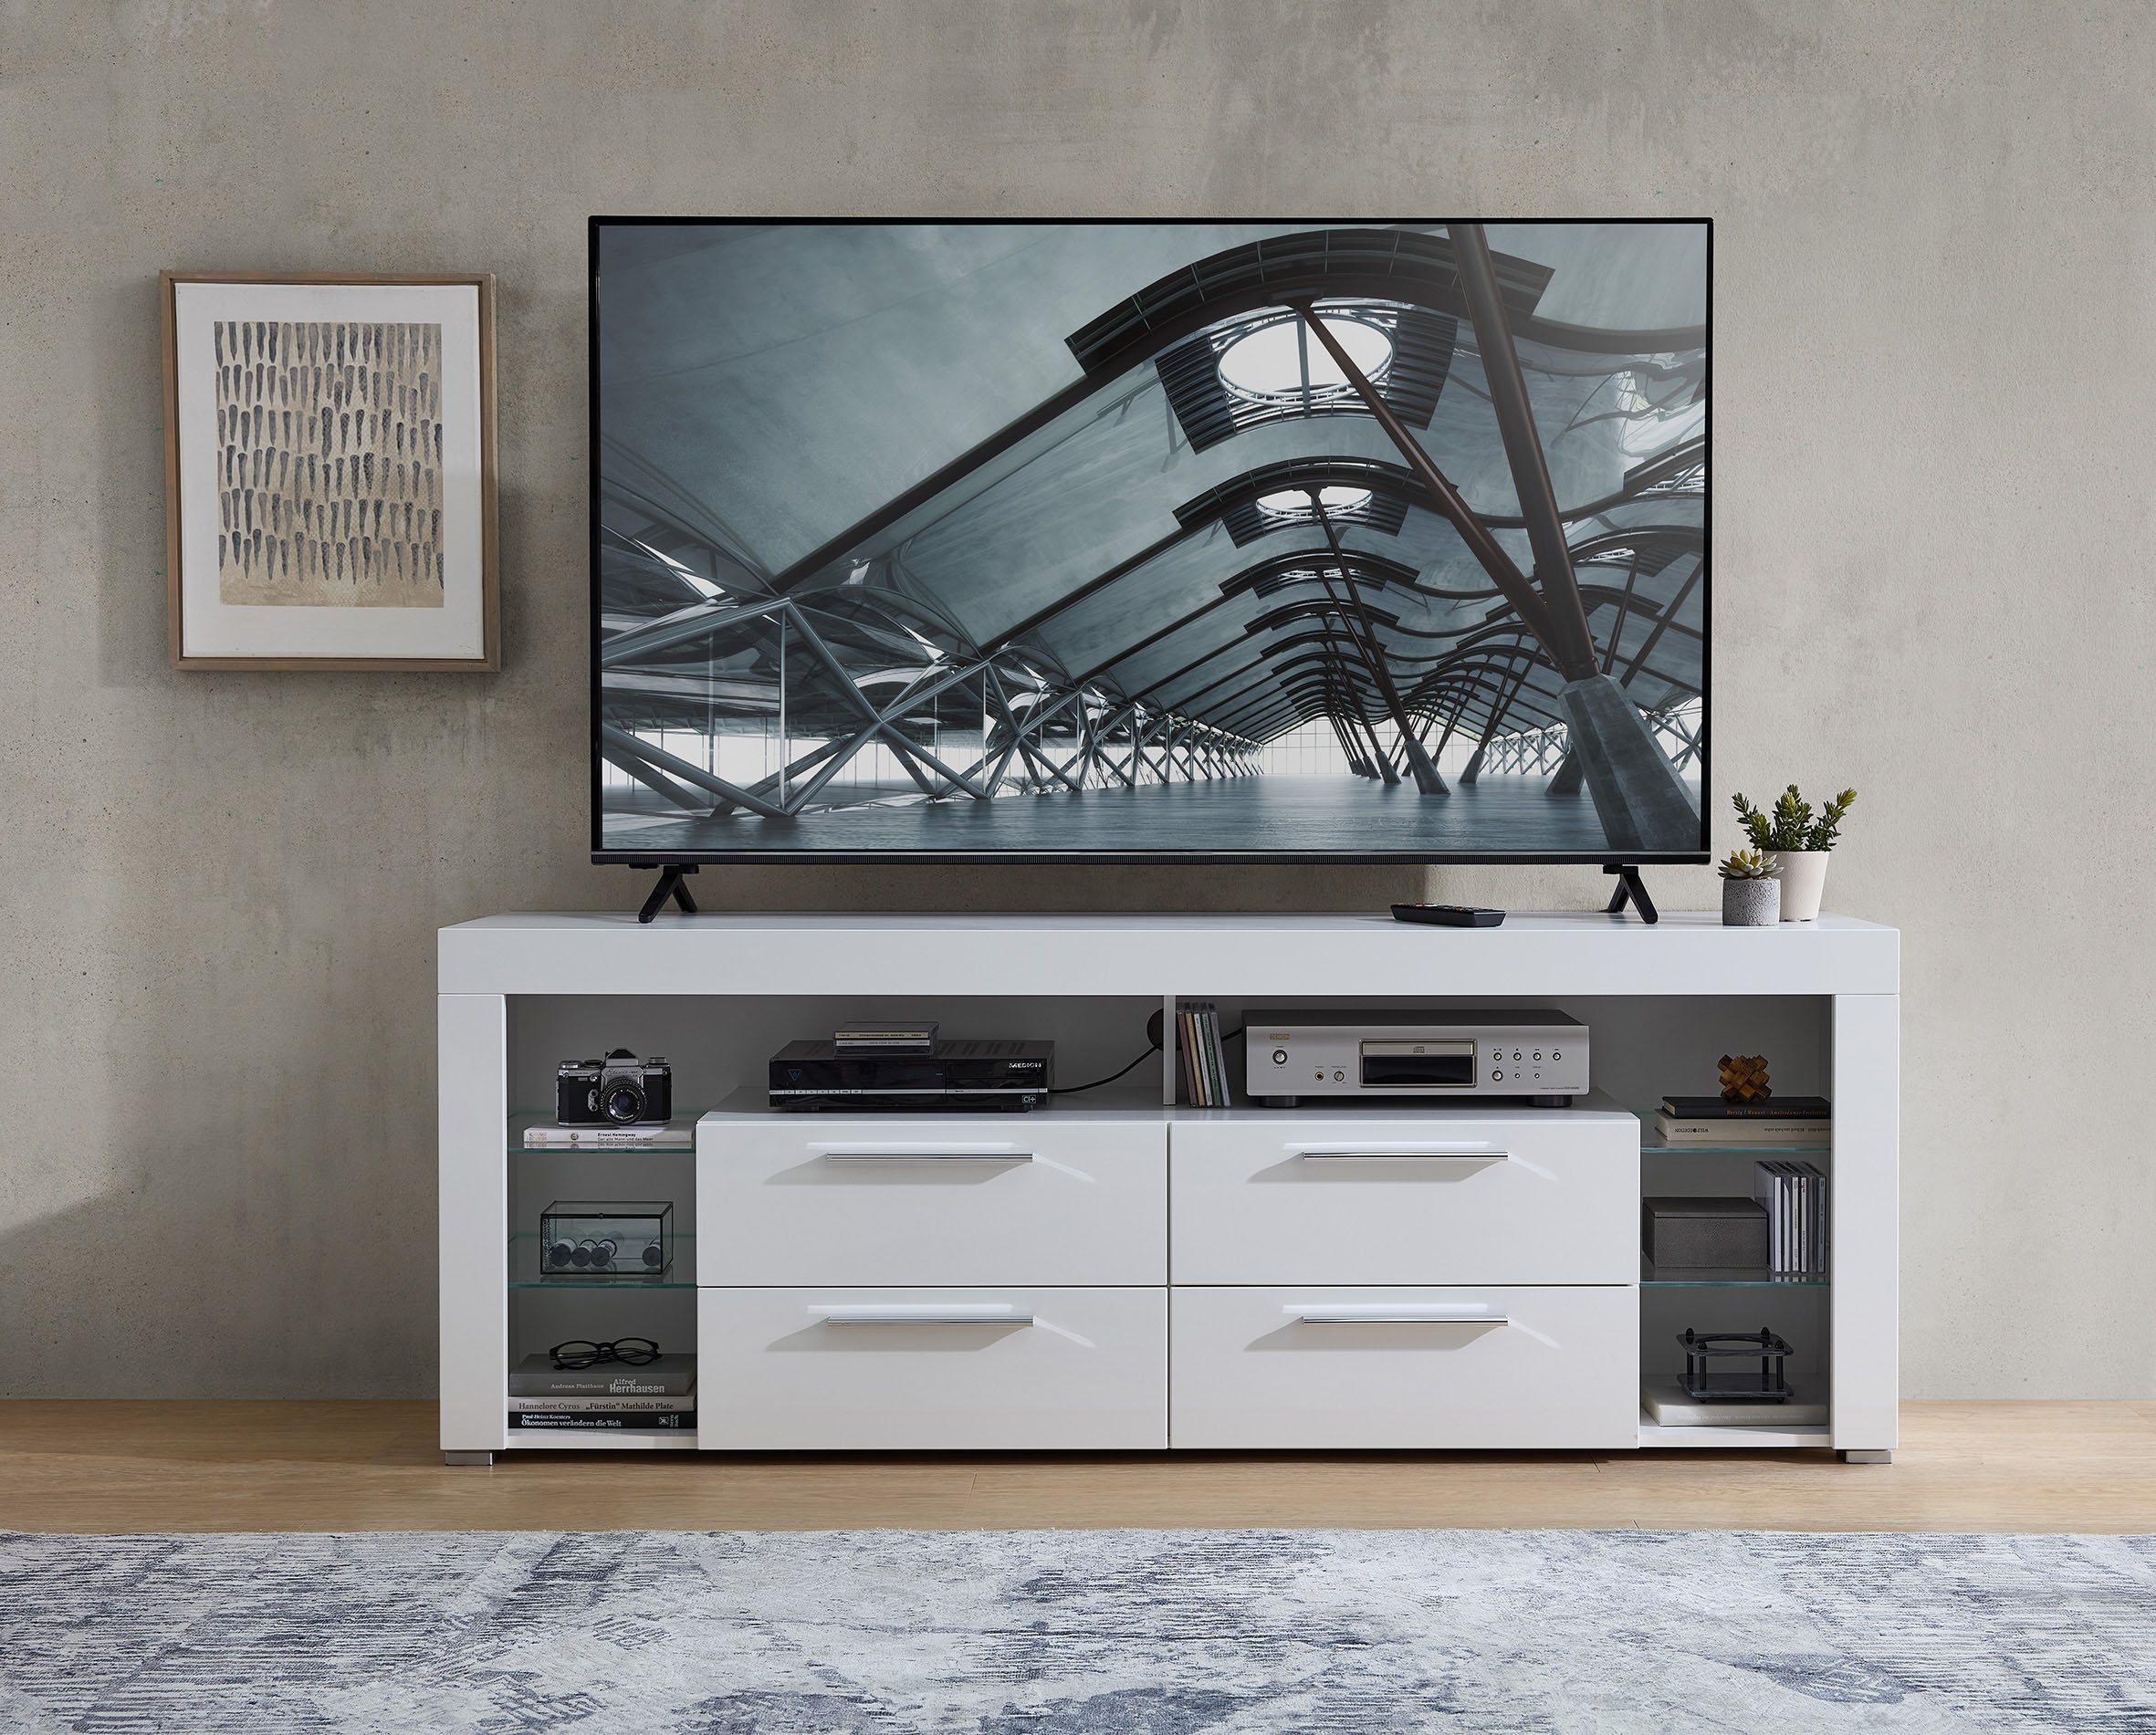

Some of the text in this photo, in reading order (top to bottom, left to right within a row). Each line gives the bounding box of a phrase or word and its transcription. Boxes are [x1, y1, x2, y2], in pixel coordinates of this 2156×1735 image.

[609, 1384, 665, 1394] Herrhausen
[518, 1402, 557, 1410] Hannelore
[559, 1403, 581, 1411] Cyrus
[622, 1402, 654, 1410] Mathilde
[655, 1402, 674, 1410] Plate
[521, 1418, 622, 1427] Ökonomen verändern die Welt
